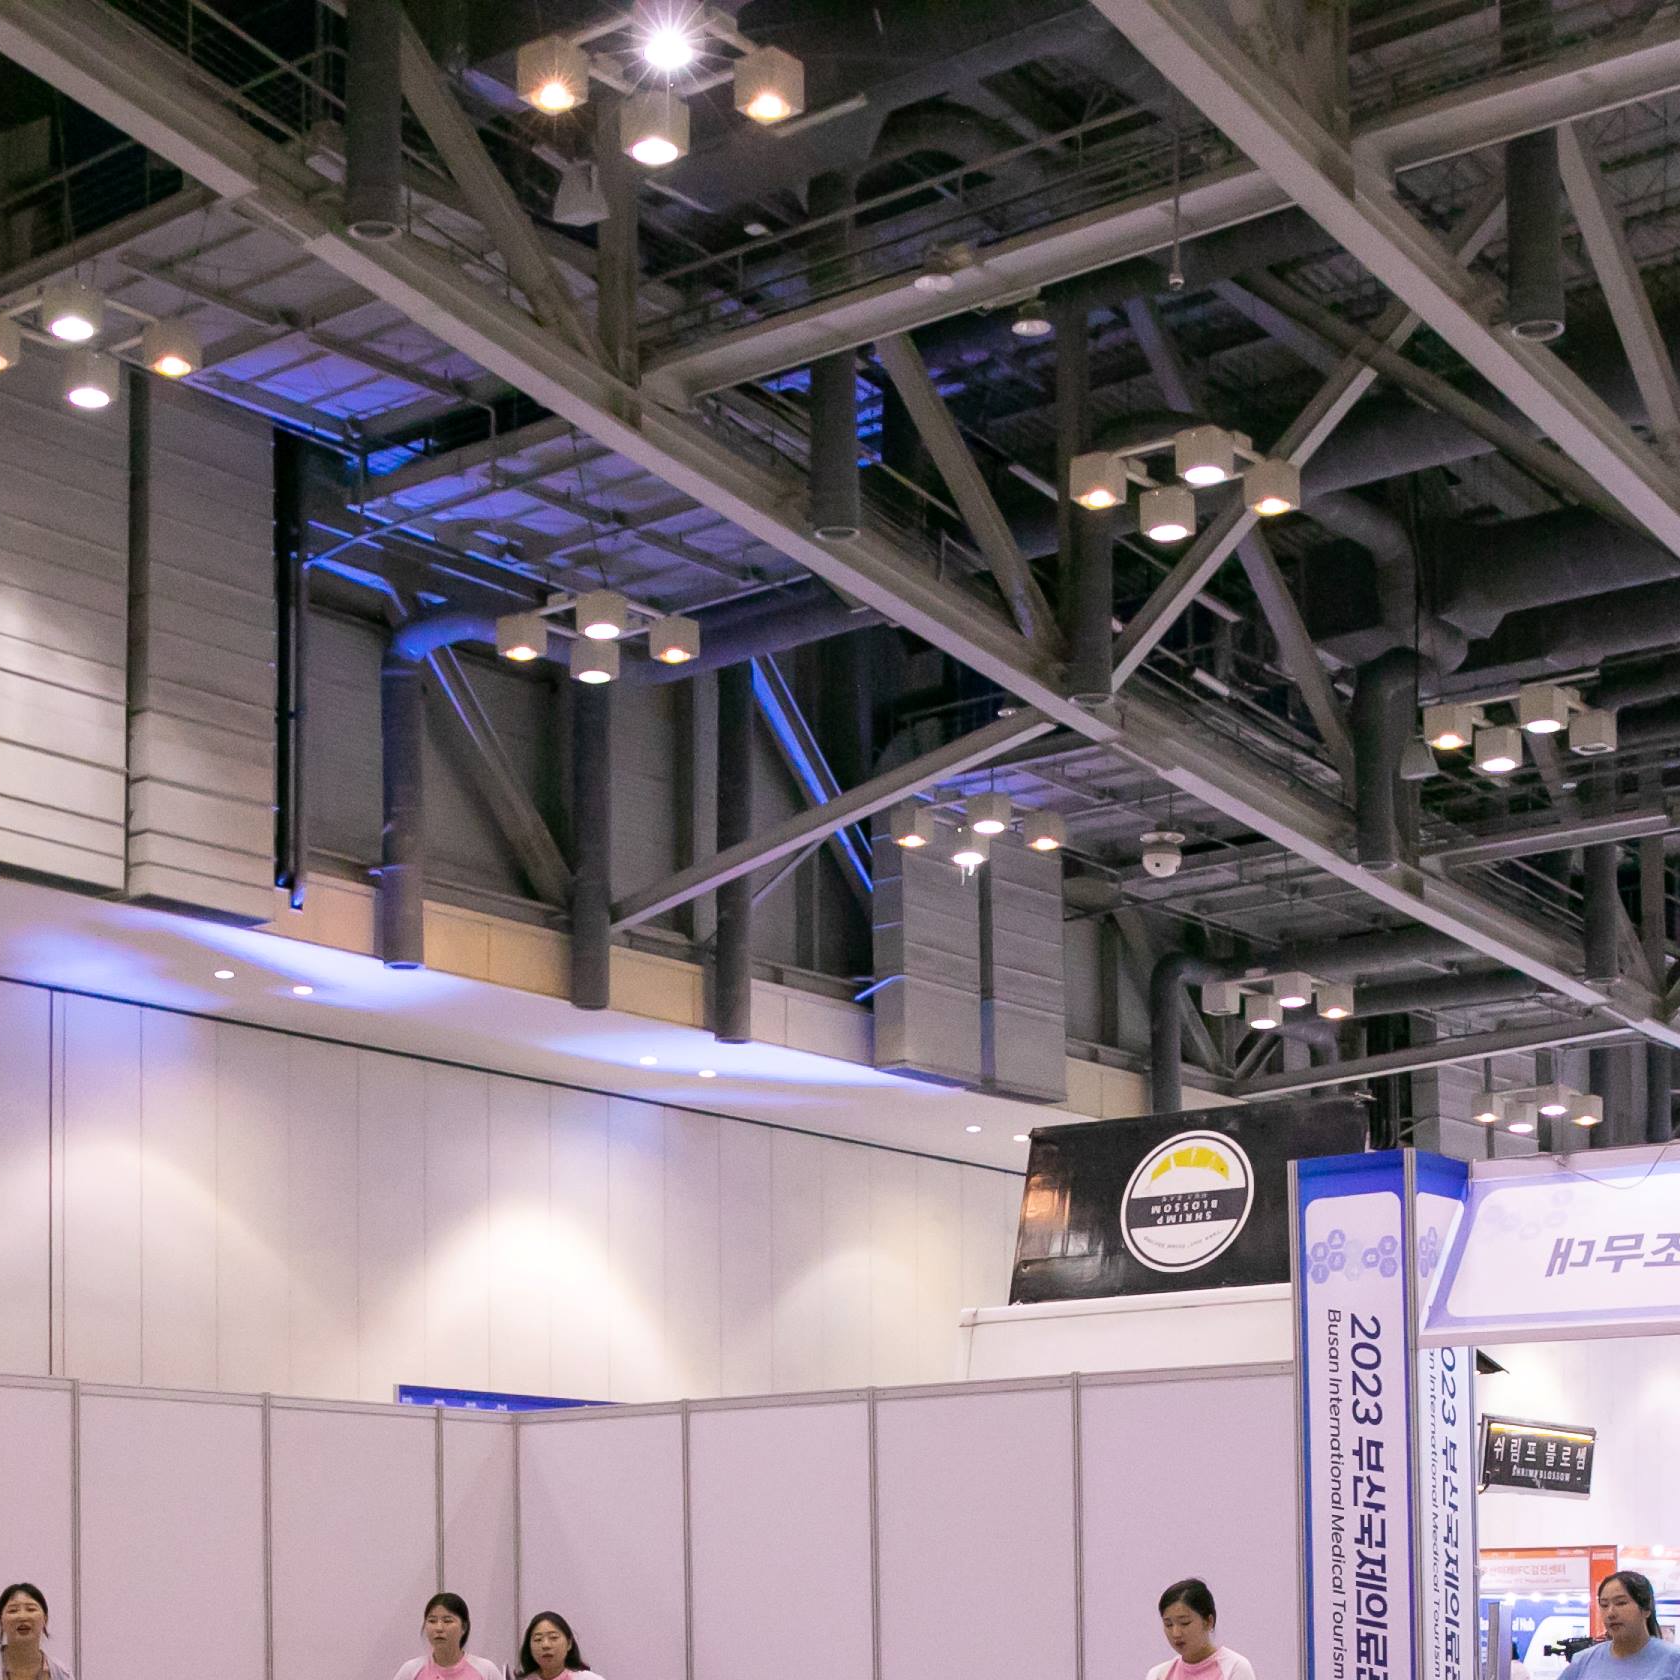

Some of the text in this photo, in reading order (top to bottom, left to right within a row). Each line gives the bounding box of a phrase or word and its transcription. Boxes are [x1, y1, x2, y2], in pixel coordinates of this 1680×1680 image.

[1150, 1199, 1218, 1215] BLOSSOM
[1156, 1210, 1213, 1225] SHRIMP
[1327, 1308, 1342, 1373] Busan
[1351, 1312, 1383, 1426] 2023
[1441, 1346, 1457, 1428] 023
[1329, 1378, 1345, 1510] International
[1331, 1514, 1346, 1595] Medical
[1332, 1599, 1347, 1680] Tourism
